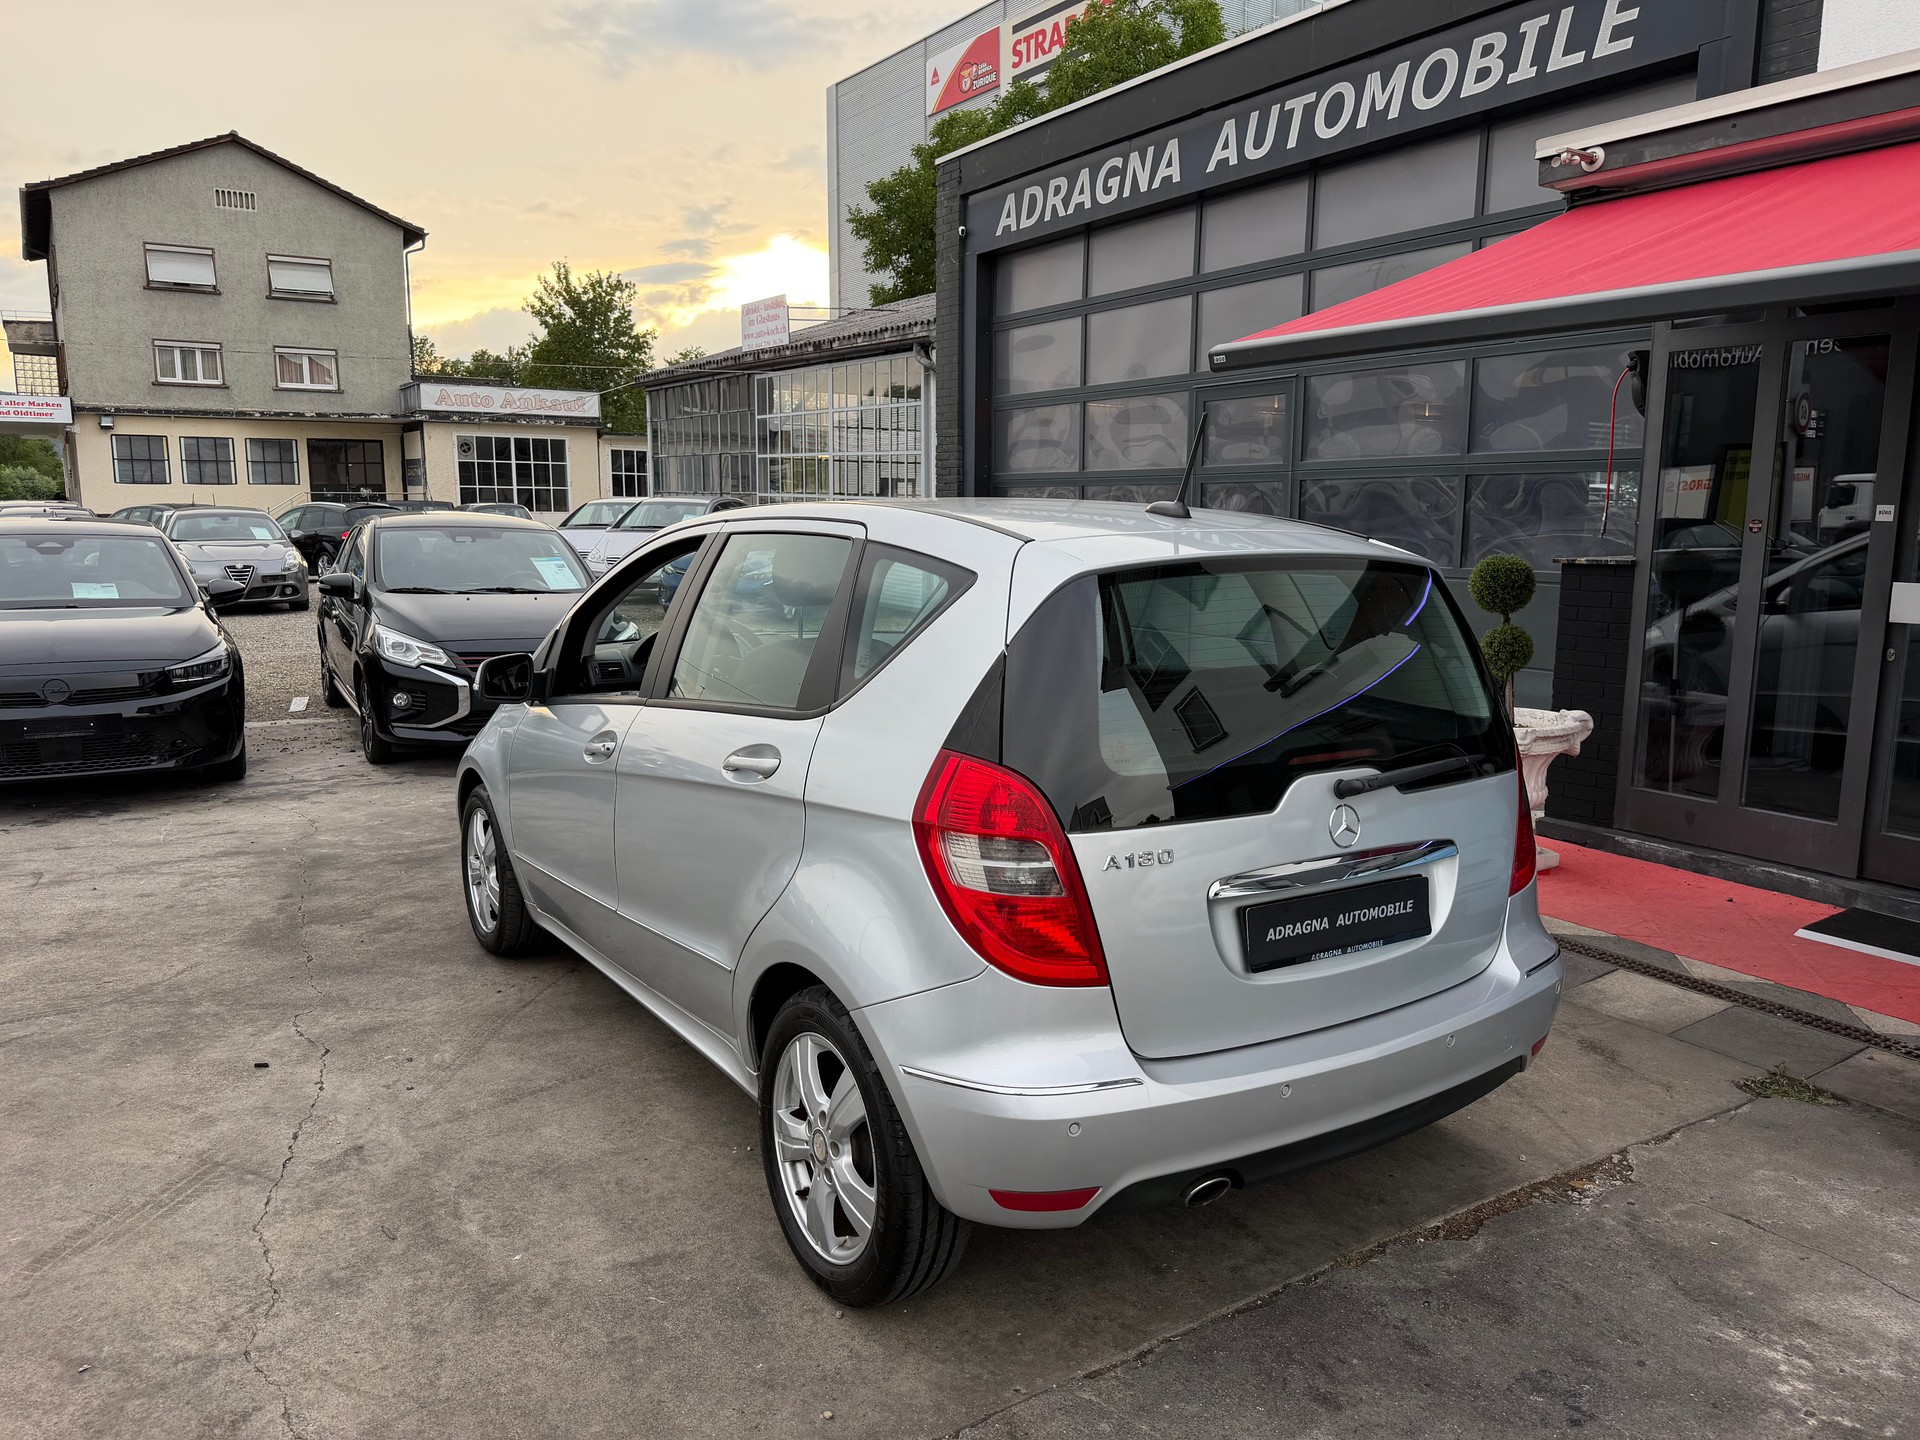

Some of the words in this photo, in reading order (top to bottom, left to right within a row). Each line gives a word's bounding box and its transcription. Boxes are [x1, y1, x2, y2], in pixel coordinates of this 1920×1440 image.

[972, 71, 997, 90] ZURIQUE
[995, 137, 1181, 237] ADRAGNA
[1206, 0, 1640, 174] AUTOMOBILE
[28, 400, 62, 408] Marken
[434, 388, 495, 408] Auto
[500, 392, 587, 413] Ankauf
[1266, 917, 1329, 942] ADRAGNA
[1336, 900, 1414, 927] AUTOMOBILE
[1311, 949, 1343, 961] ADRAGNA
[1346, 939, 1384, 954] AUTOMOBILE
